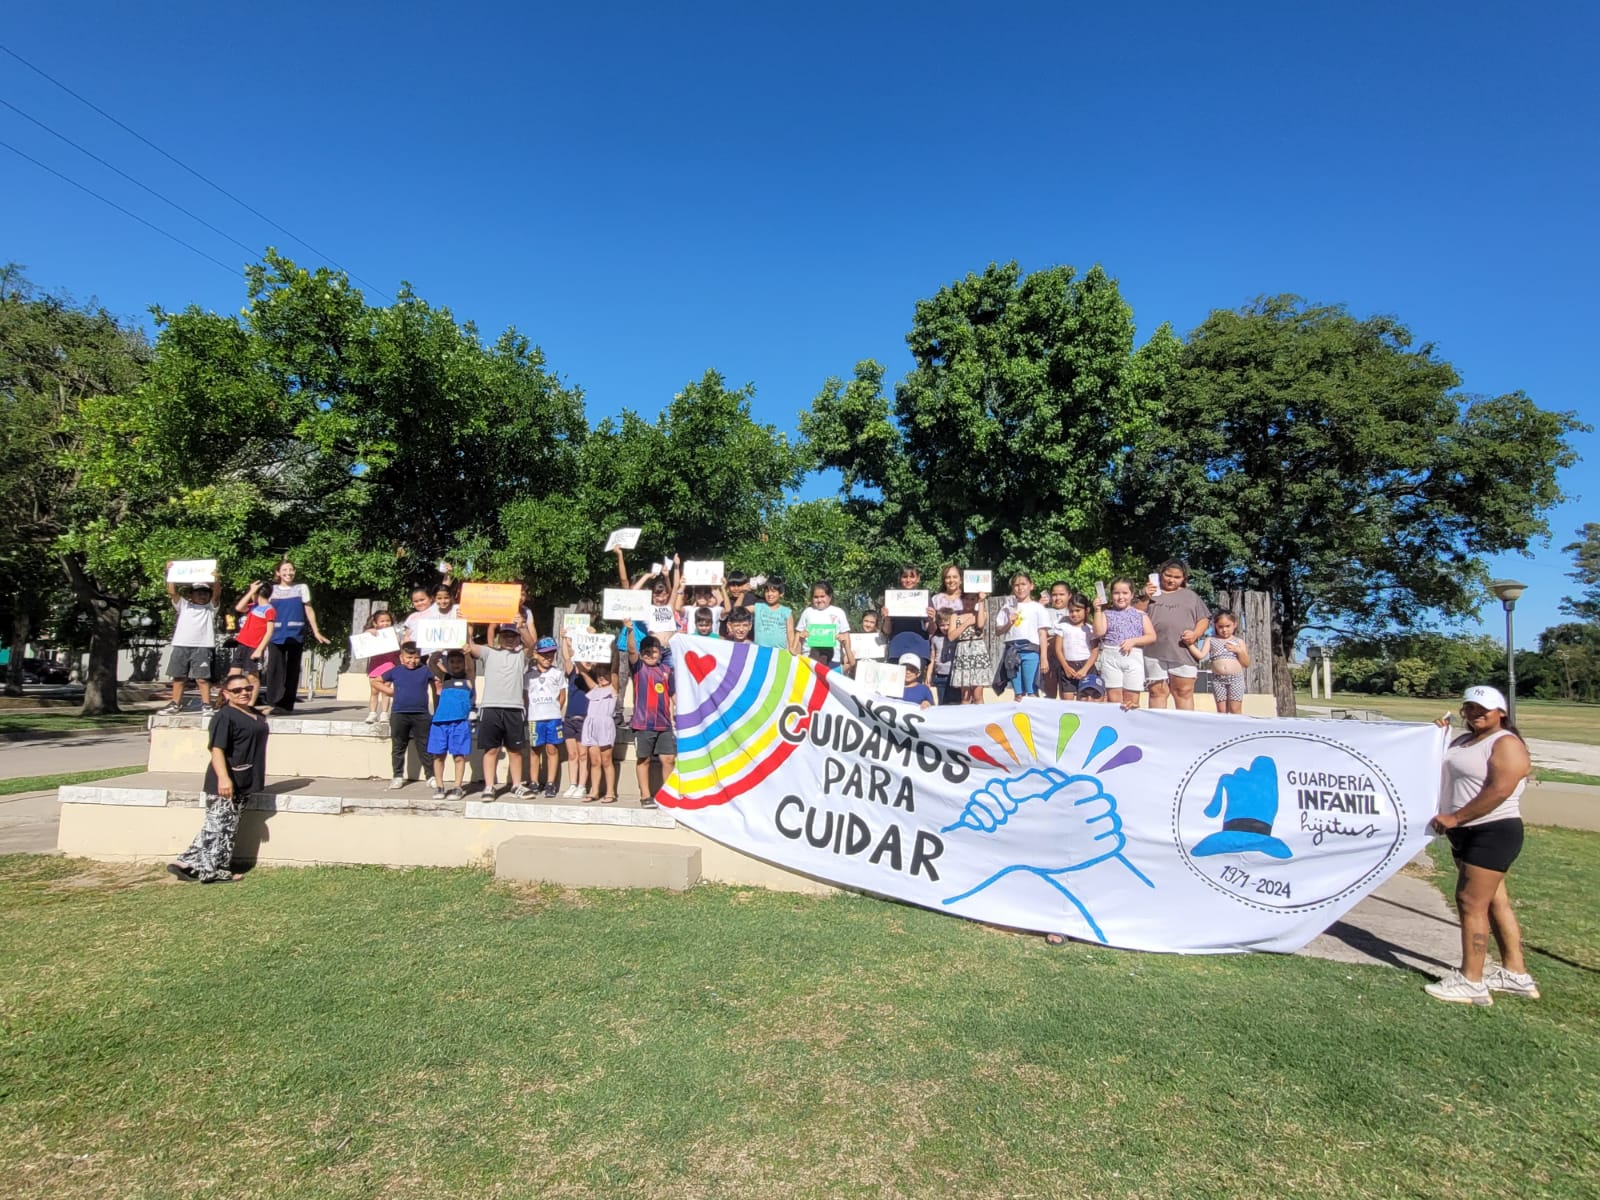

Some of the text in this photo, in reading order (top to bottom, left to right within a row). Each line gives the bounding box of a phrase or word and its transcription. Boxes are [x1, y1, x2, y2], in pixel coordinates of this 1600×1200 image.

[850, 694, 925, 739] NOS
[778, 704, 972, 784] CUIDAMOS
[823, 757, 915, 812] PARA
[1287, 770, 1375, 792] GUARDERÍA
[1297, 789, 1380, 815] INFANTIL
[775, 795, 944, 882] CUIDAR
